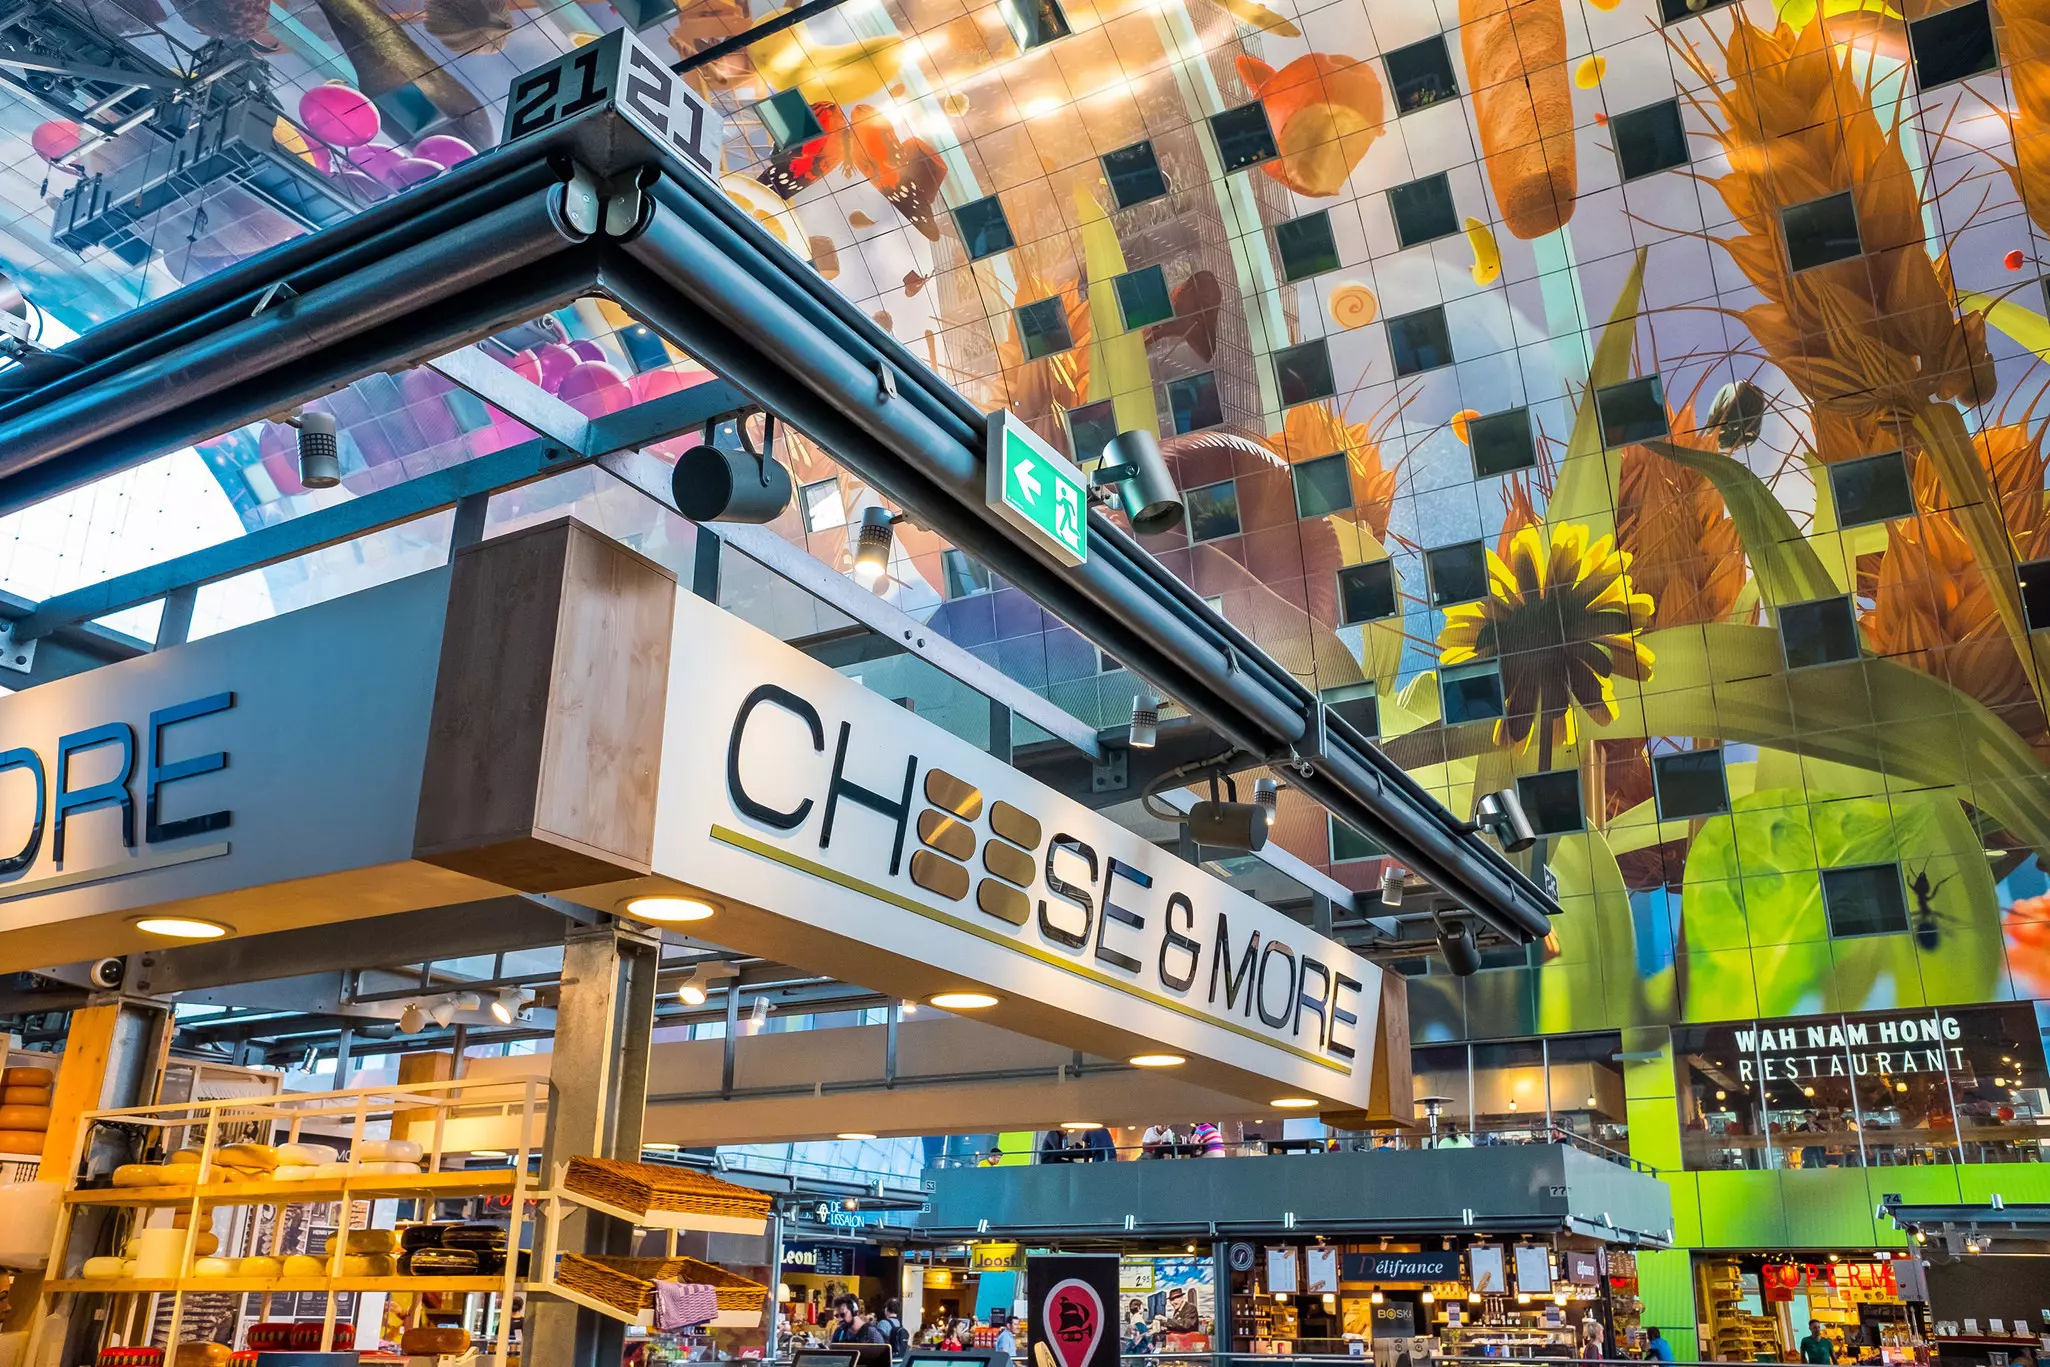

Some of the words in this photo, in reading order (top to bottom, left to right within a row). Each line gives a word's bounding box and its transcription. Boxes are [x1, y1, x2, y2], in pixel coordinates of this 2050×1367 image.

[511, 49, 607, 140] 21
[626, 44, 712, 174] 21
[1160, 891, 1201, 991] &
[1208, 913, 1363, 1059] MORE
[1735, 1028, 1797, 1052] WAH
[1807, 1023, 1868, 1048] NAM
[1878, 1017, 1961, 1043] HONG
[1739, 1047, 1963, 1081] RESTAURANT
[831, 1201, 842, 1213] DE
[1550, 1187, 1566, 1195] 77
[1359, 1256, 1443, 1278] Délifrance
